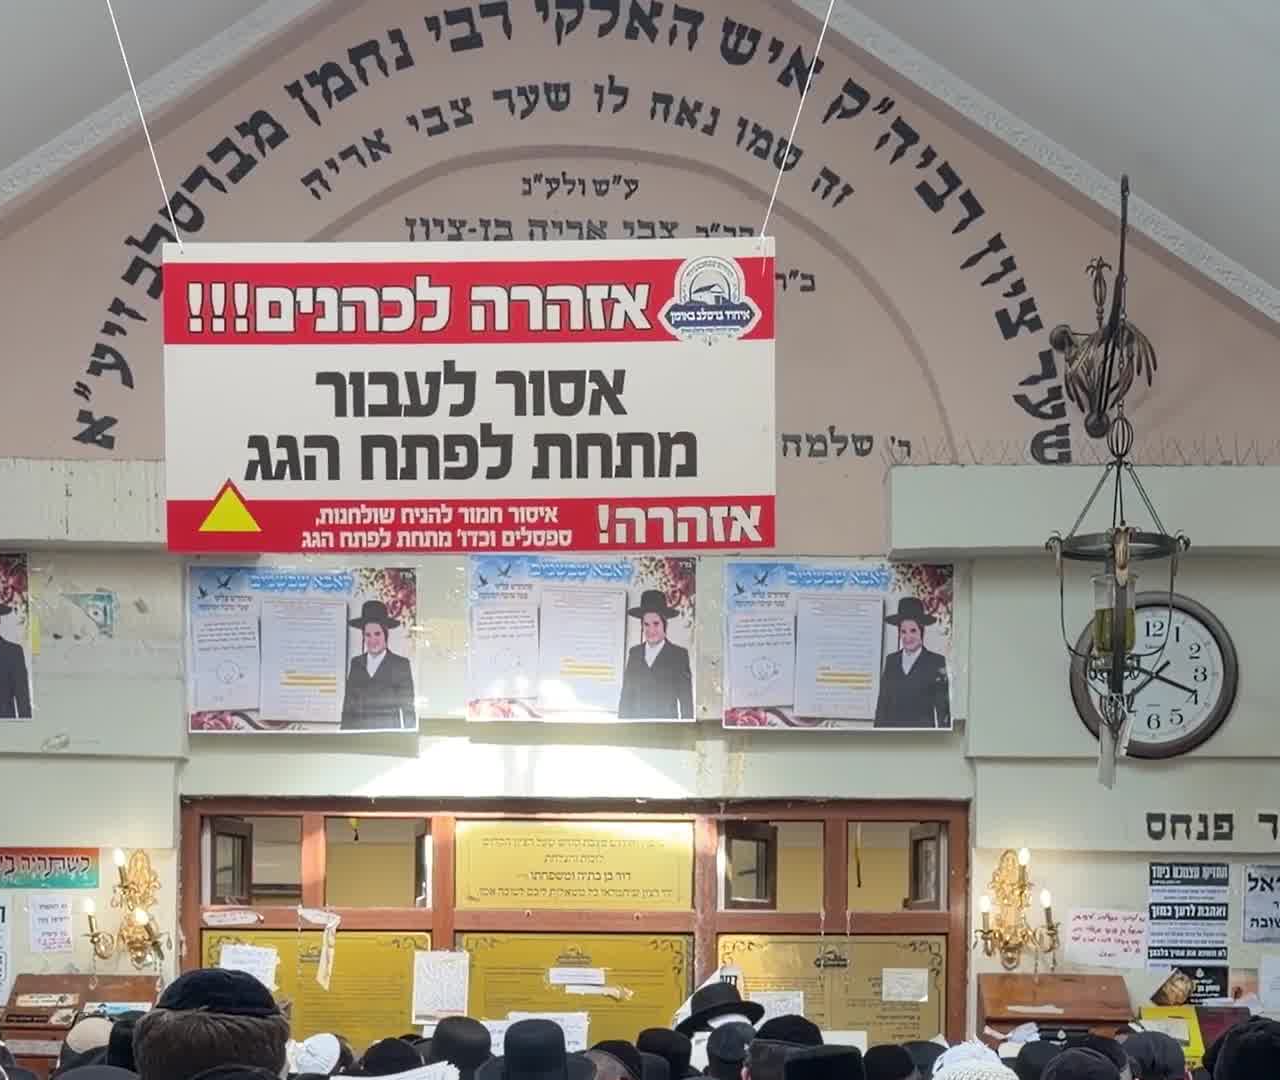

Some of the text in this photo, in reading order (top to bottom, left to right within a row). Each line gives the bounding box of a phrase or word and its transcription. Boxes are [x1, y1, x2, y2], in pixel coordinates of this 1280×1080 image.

[424, 0, 514, 53] רבי
[283, 27, 416, 127] נחמן
[720, 17, 825, 98] איש
[491, 82, 572, 121] שער
[593, 74, 631, 115] לו
[406, 97, 475, 137] צבי
[736, 115, 804, 172] שמו
[300, 127, 393, 200] אריה
[811, 166, 855, 208] זה
[186, 273, 653, 335] אזהרה לכהנים!!!
[959, 231, 1045, 340] ציון
[314, 359, 628, 418] אסור לעבור
[1012, 348, 1072, 465] שער
[243, 422, 698, 481] מתחת לפתח הגג
[401, 502, 454, 526] להניח
[458, 506, 503, 526] חמור
[508, 505, 560, 525] איסור
[596, 503, 763, 545] אזהרה!
[301, 530, 335, 550] הגג
[338, 527, 391, 550] לפתח
[395, 530, 452, 549] מתחת
[501, 529, 573, 548] ספסלים
[1145, 619, 1164, 637] 12
[1175, 625, 1180, 643] 1
[1188, 643, 1201, 660] 2
[1193, 666, 1208, 682] 3
[1146, 712, 1161, 731] 6
[1170, 708, 1184, 726] 5
[1145, 811, 1235, 842] פנחס
